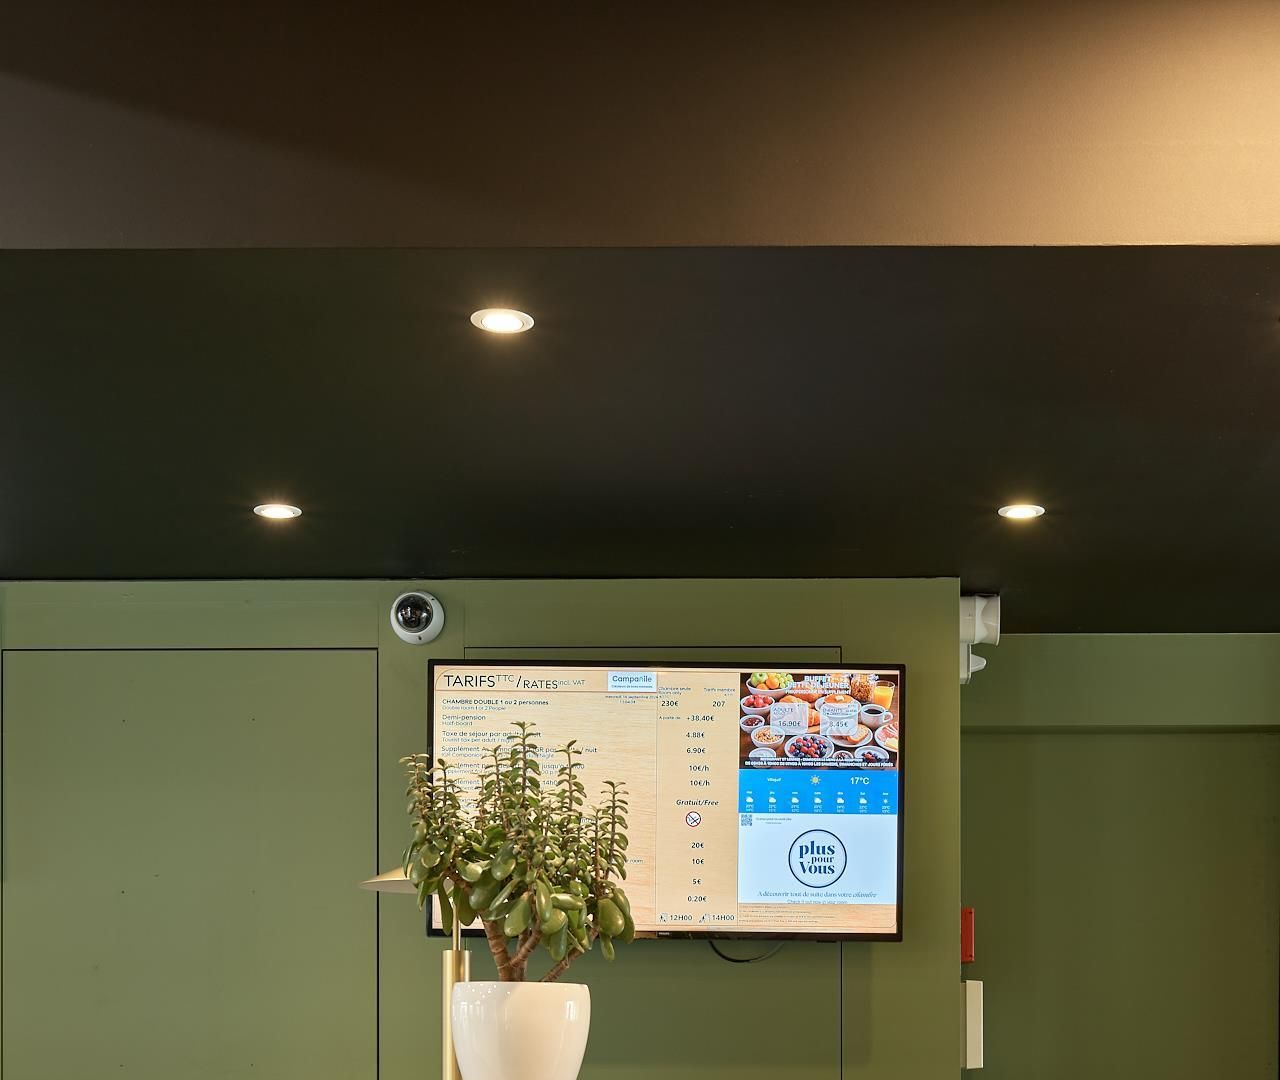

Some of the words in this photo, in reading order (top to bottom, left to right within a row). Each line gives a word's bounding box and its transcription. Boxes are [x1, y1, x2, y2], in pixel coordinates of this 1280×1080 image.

[443, 674, 495, 687] TARIFS
[496, 674, 514, 682] TTC
[523, 680, 558, 689] RATES
[612, 675, 652, 685] Campanile
[469, 730, 488, 738] séjour
[689, 764, 709, 772] 10€/h
[850, 776, 870, 785] 17°C
[799, 840, 835, 858] plus
[811, 856, 834, 864] pour
[800, 861, 835, 874] Vous
